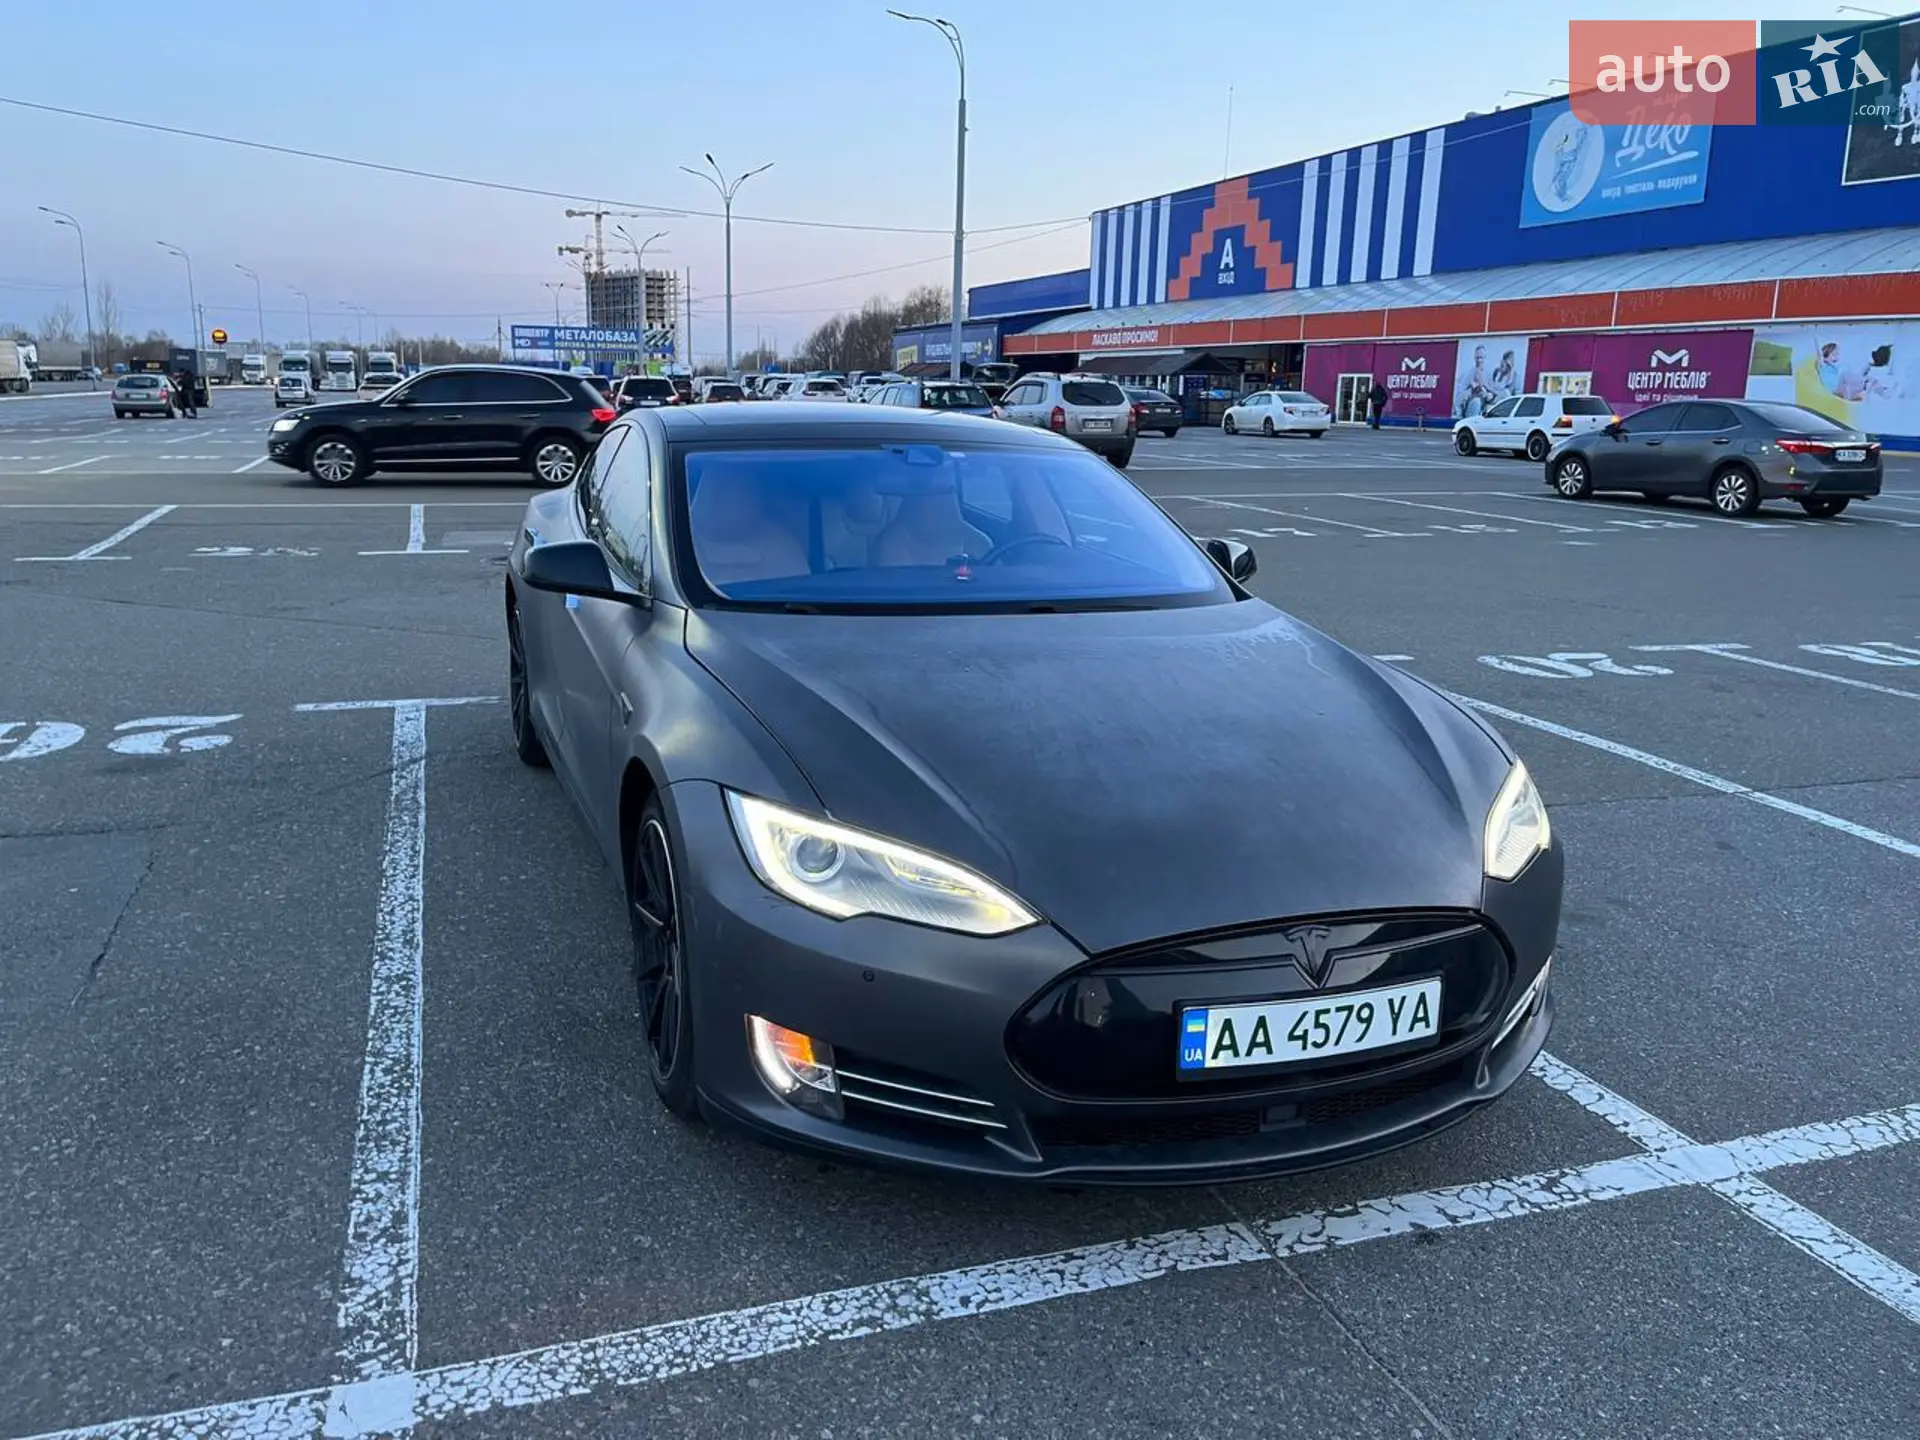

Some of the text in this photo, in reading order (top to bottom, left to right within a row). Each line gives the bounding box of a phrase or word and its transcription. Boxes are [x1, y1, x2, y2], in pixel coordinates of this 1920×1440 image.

[554, 329, 638, 342] МЕТАЛОБАЗА
[1387, 374, 1439, 389] ЦЕНТР МЕБЛІВ
[1627, 371, 1709, 390] ЦЕНТР МЕБЛІВ
[1211, 991, 1431, 1060] AA 4579 YA
[1184, 1048, 1204, 1062] UA
